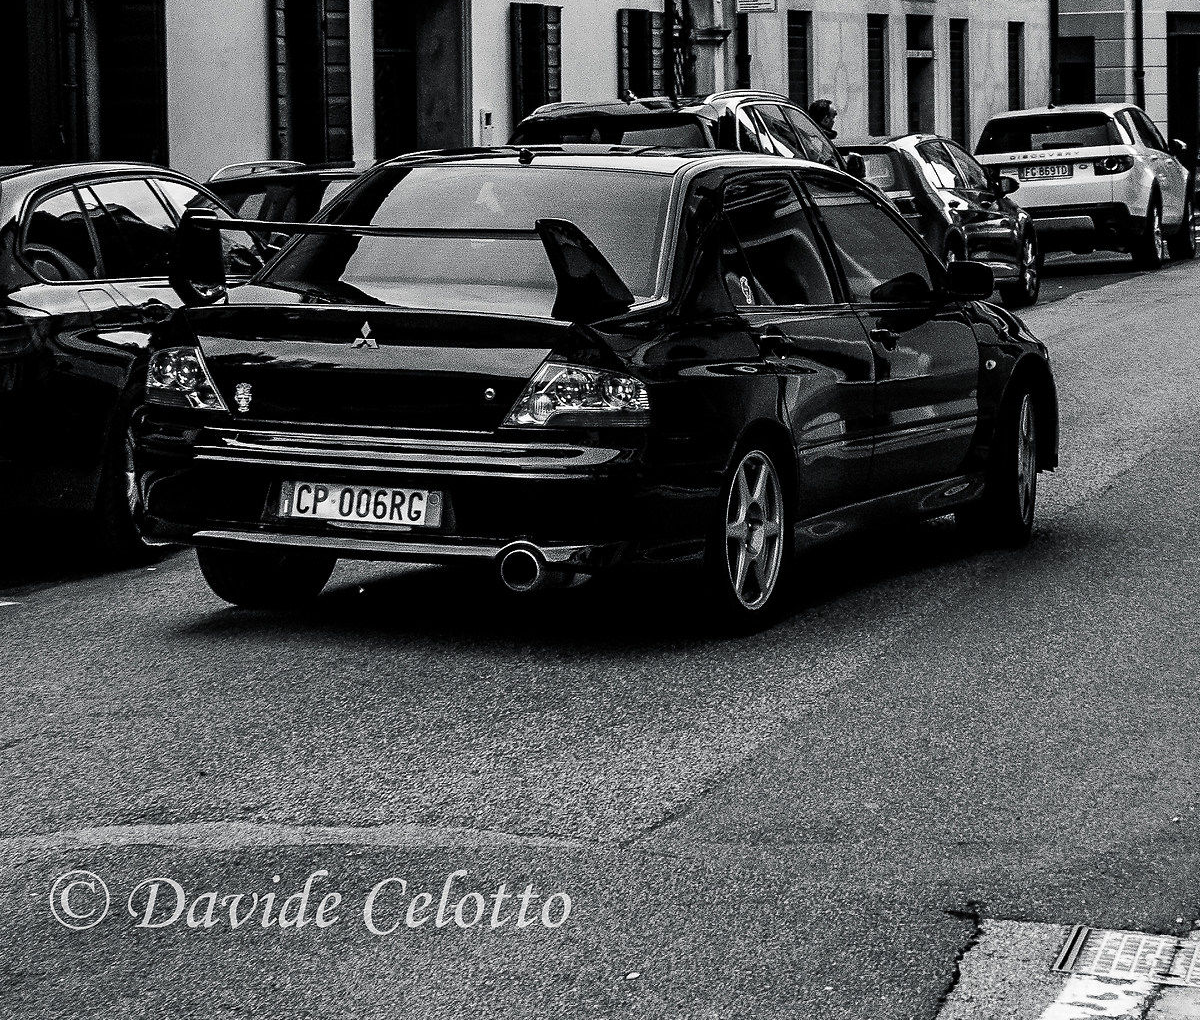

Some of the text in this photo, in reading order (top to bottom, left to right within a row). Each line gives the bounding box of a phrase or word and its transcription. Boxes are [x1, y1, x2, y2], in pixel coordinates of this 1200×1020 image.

[1009, 151, 1080, 161] DISCOVERY
[296, 484, 329, 515] CP
[338, 487, 424, 521] 006RG
